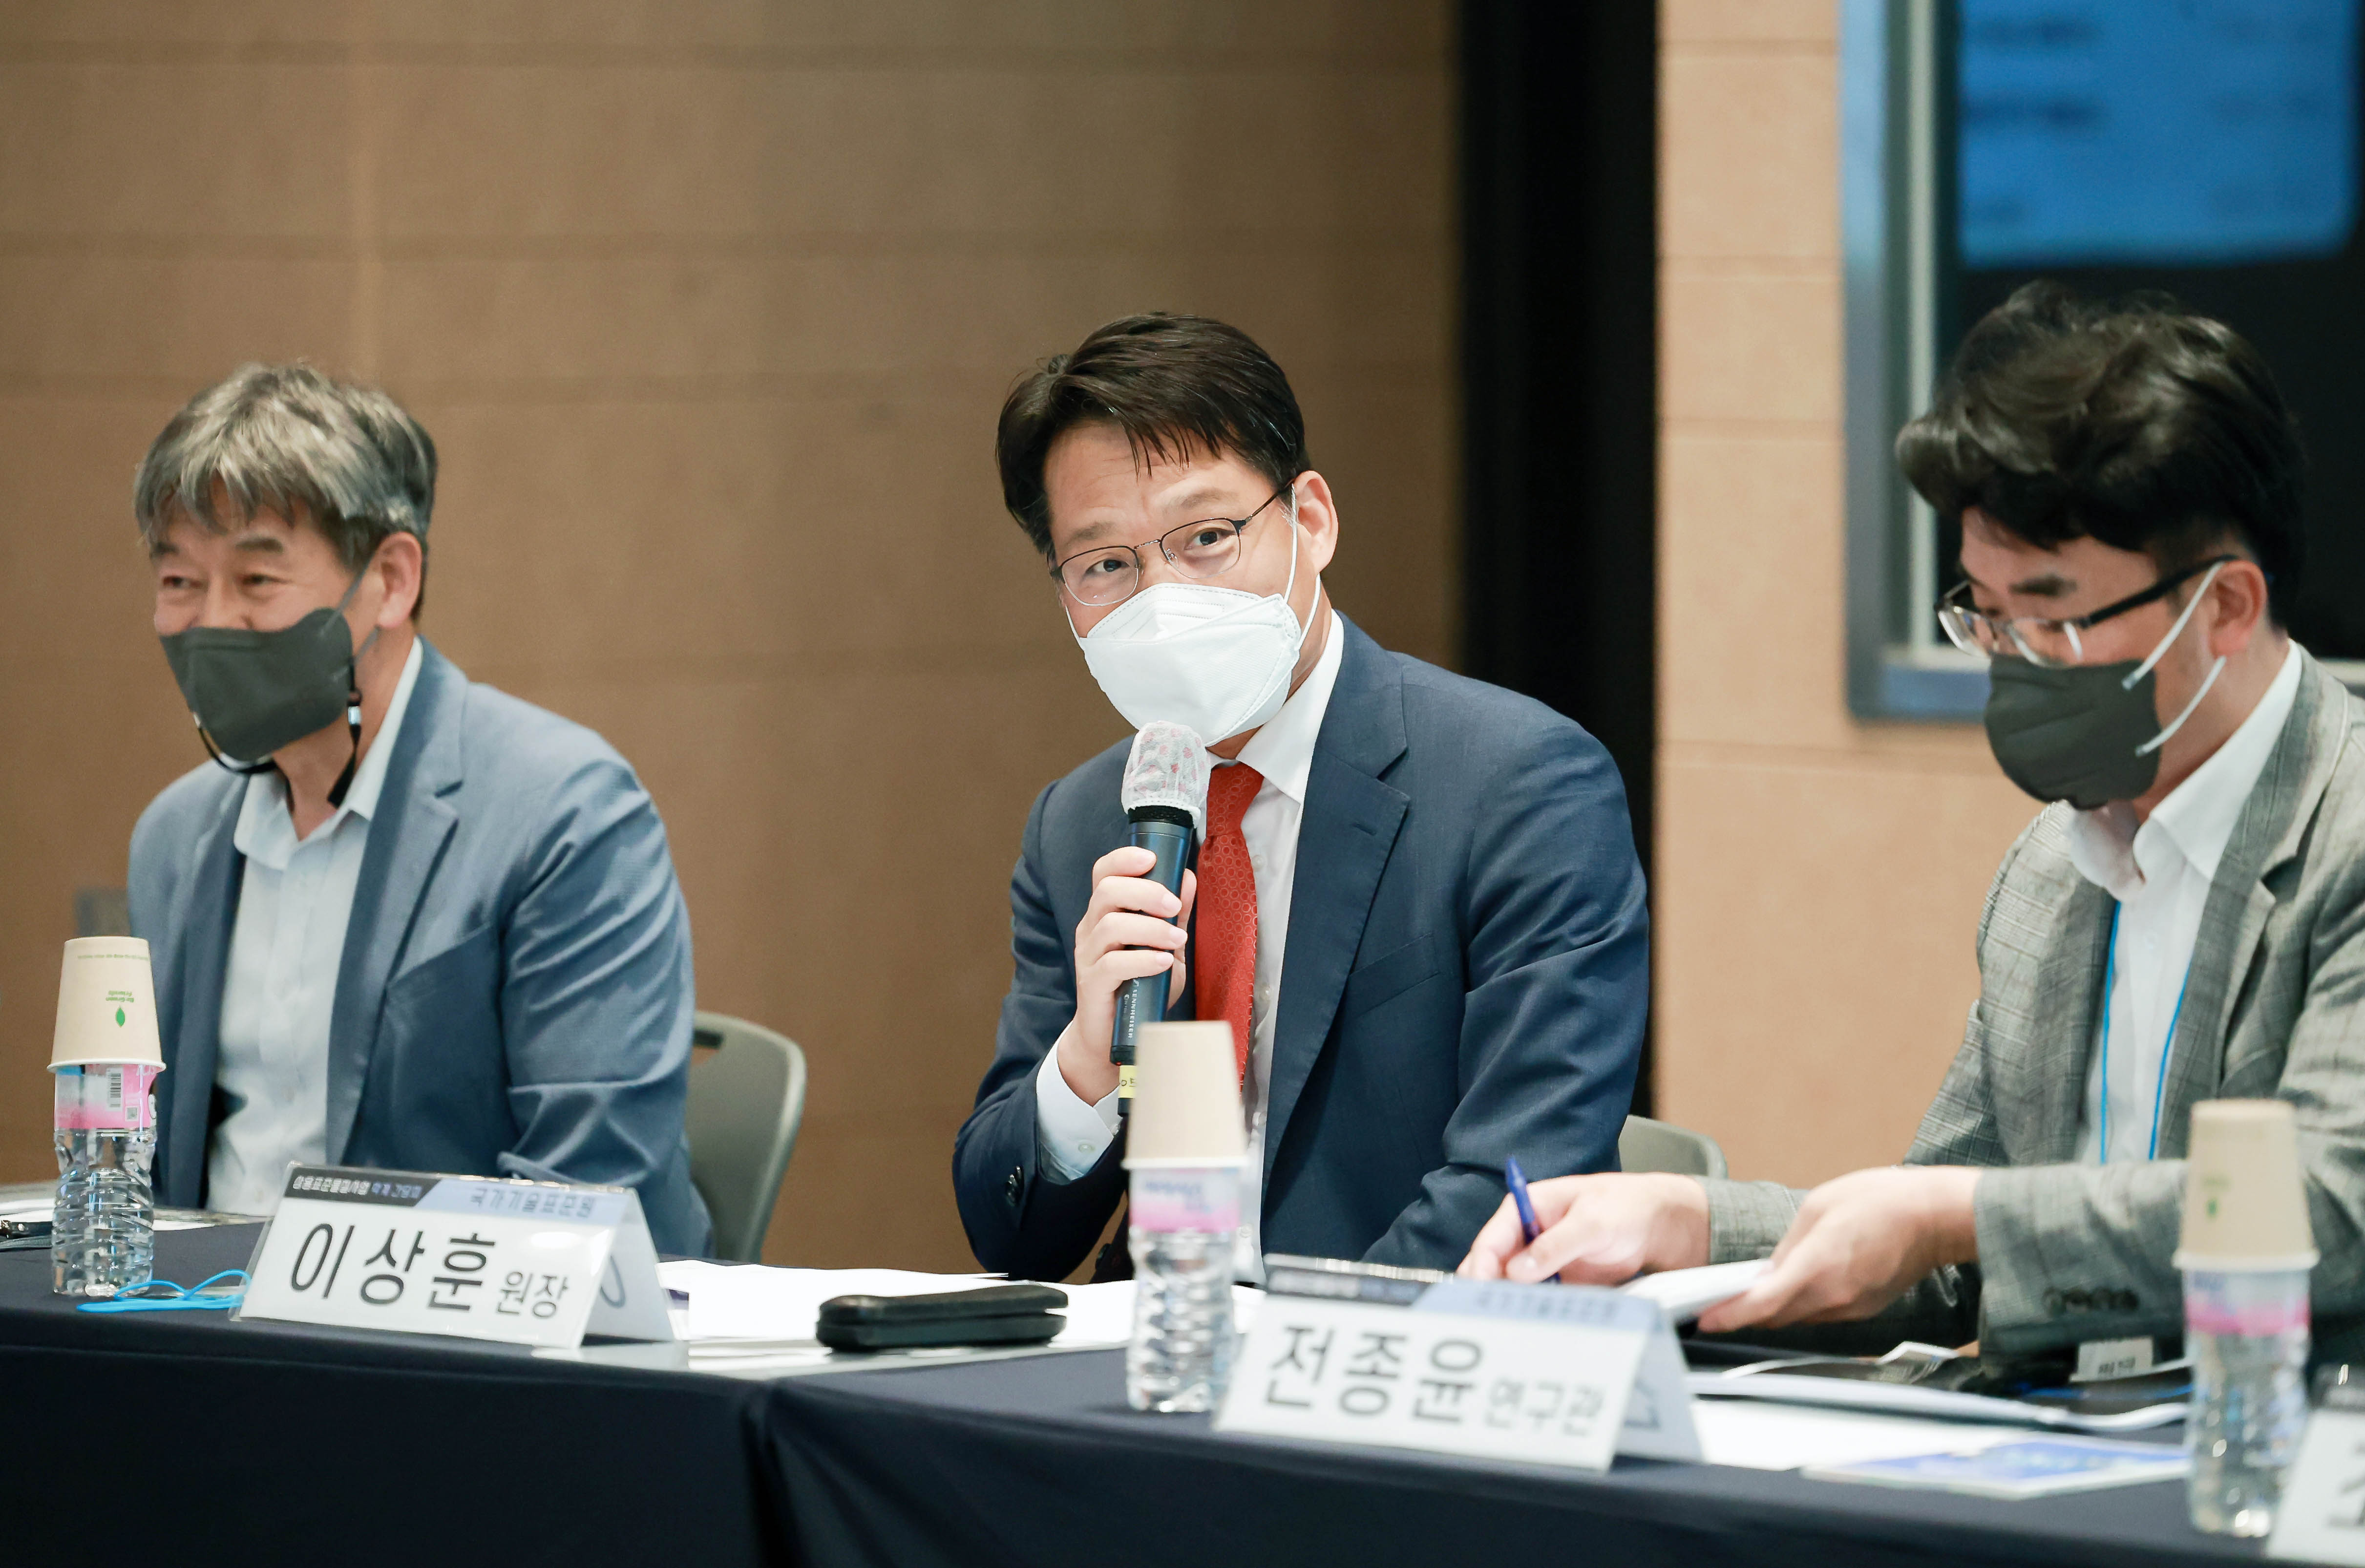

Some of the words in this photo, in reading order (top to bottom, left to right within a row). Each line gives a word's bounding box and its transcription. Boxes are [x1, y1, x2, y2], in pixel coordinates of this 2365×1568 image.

[1128, 989, 1138, 1038] SENNHEISER
[291, 1223, 496, 1311] 이상훈
[497, 1271, 570, 1318] 원장
[1264, 1323, 1481, 1424] 전종윤
[1484, 1376, 1605, 1438] 연구관
